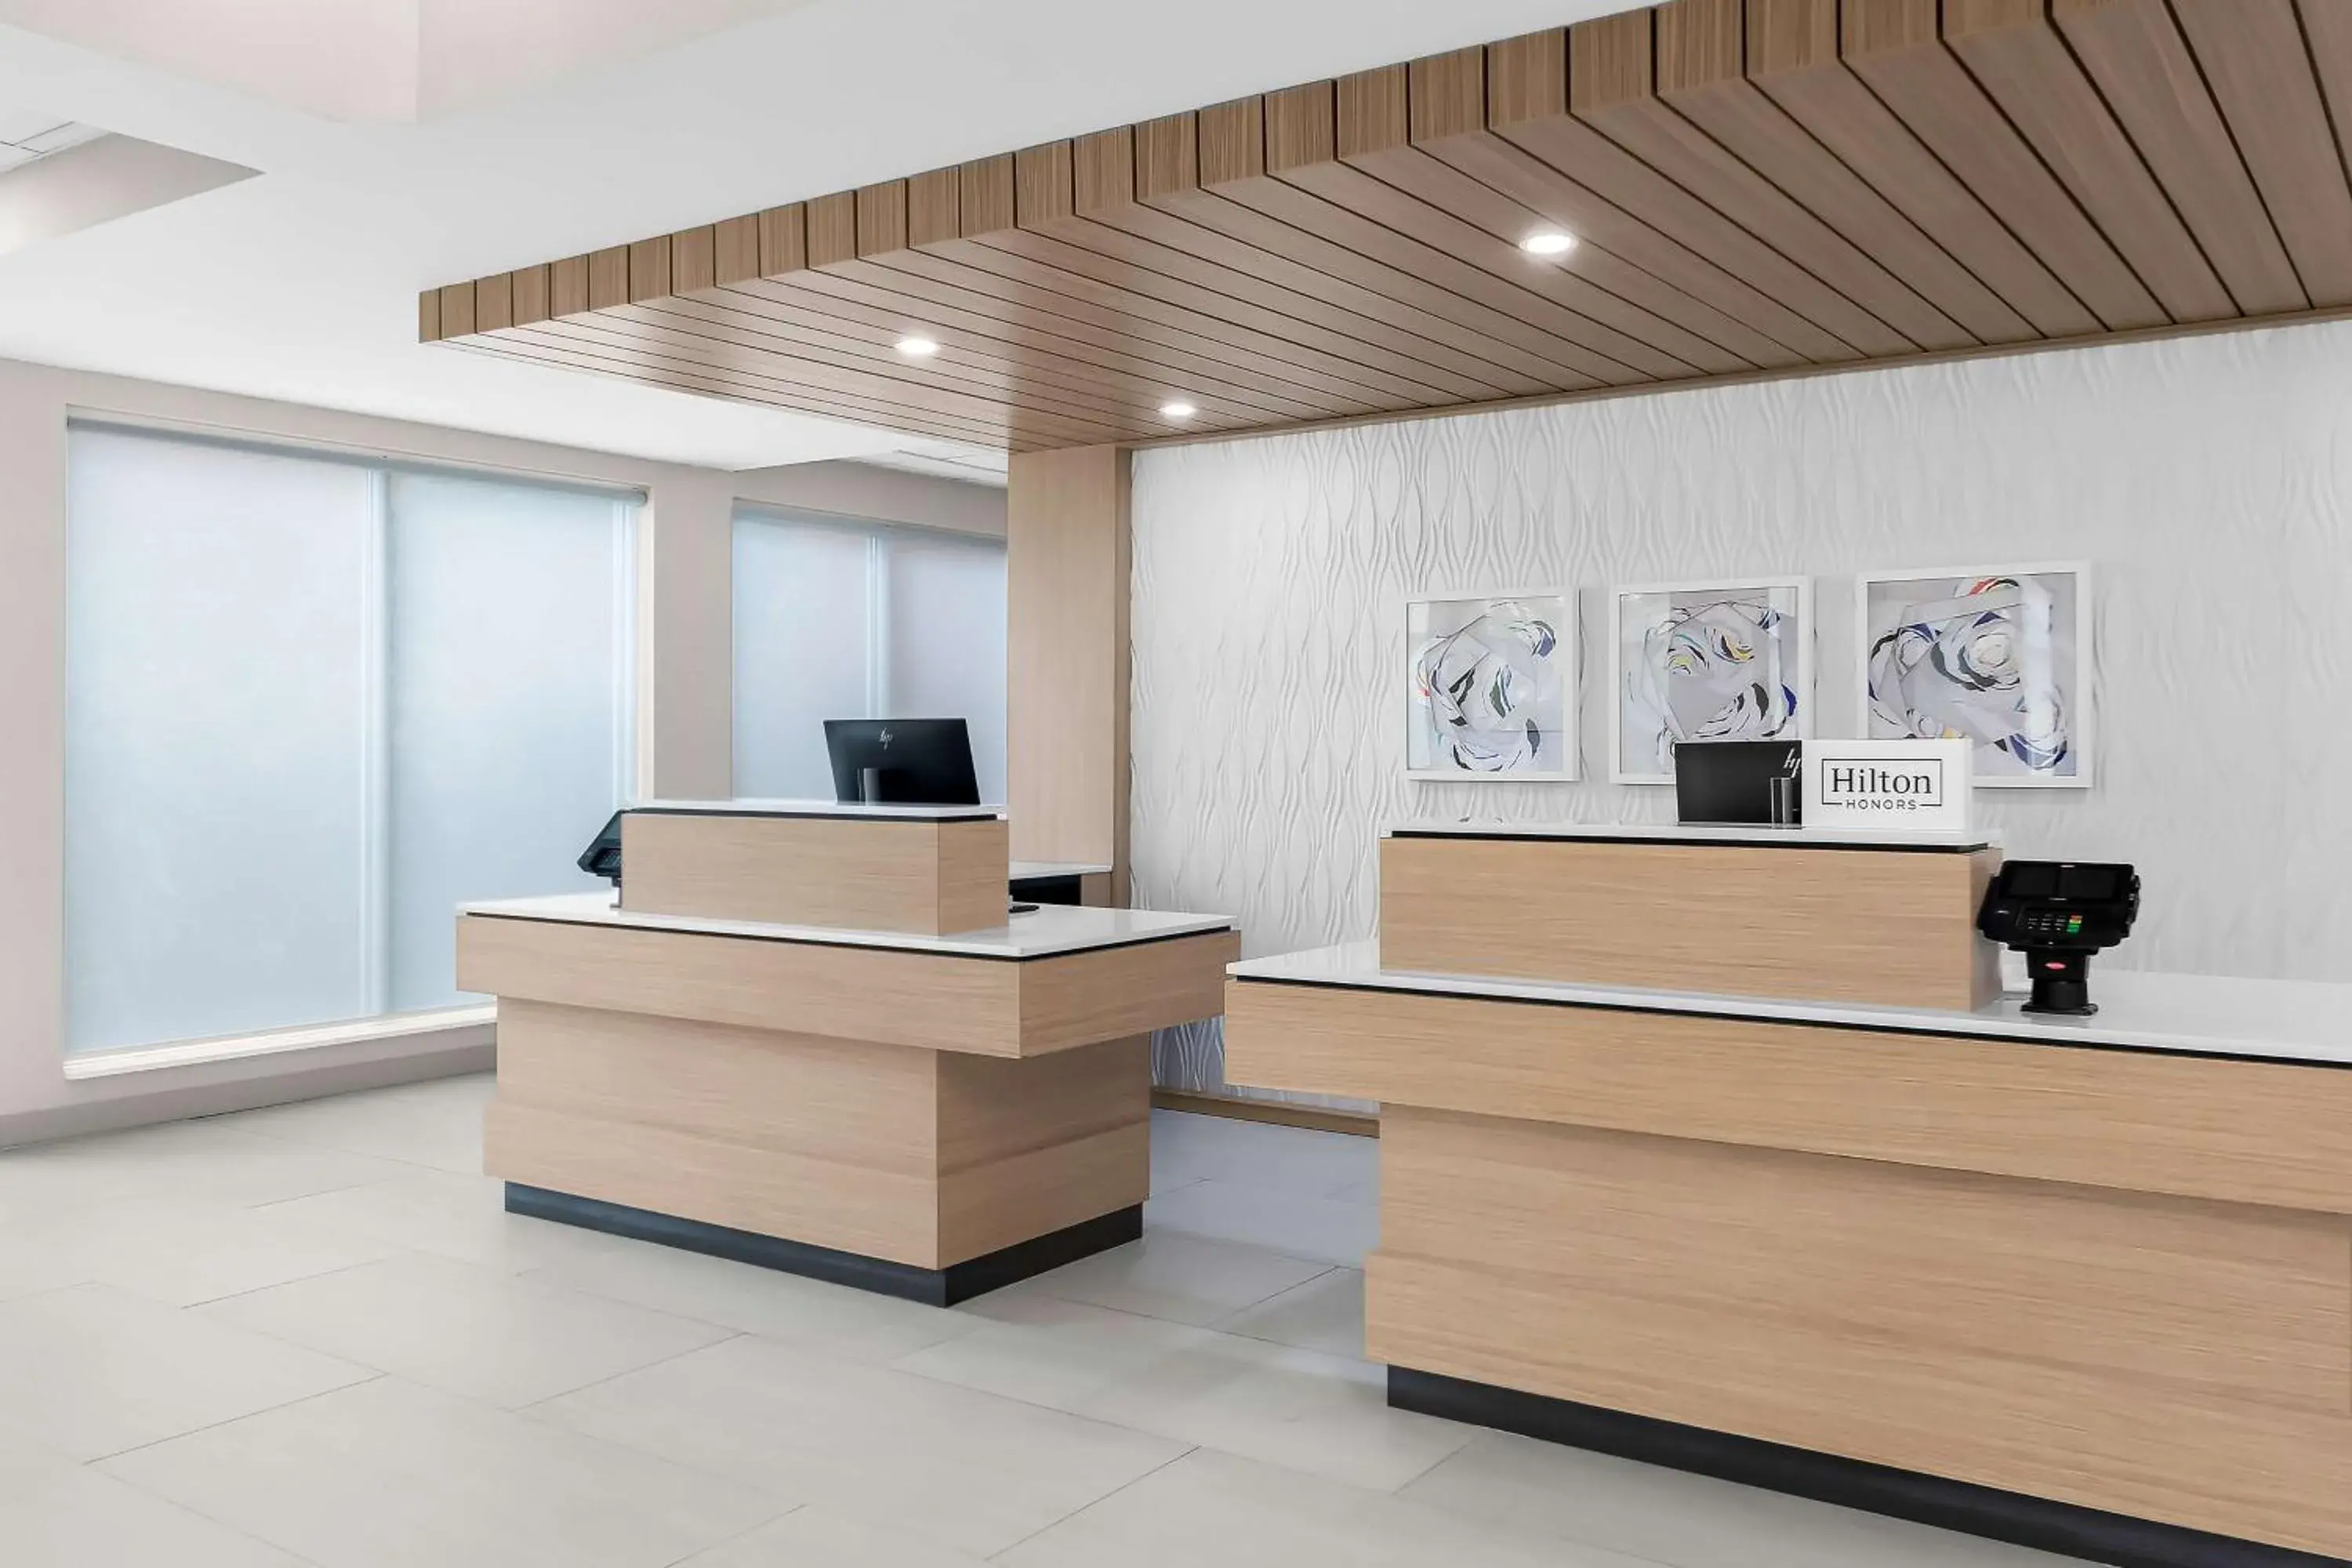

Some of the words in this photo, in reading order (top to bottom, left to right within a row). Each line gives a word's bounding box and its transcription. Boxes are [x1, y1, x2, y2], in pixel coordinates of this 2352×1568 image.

[879, 728, 893, 750] hp
[1831, 768, 1933, 794] Hilton
[1846, 799, 1918, 811] HONORS
